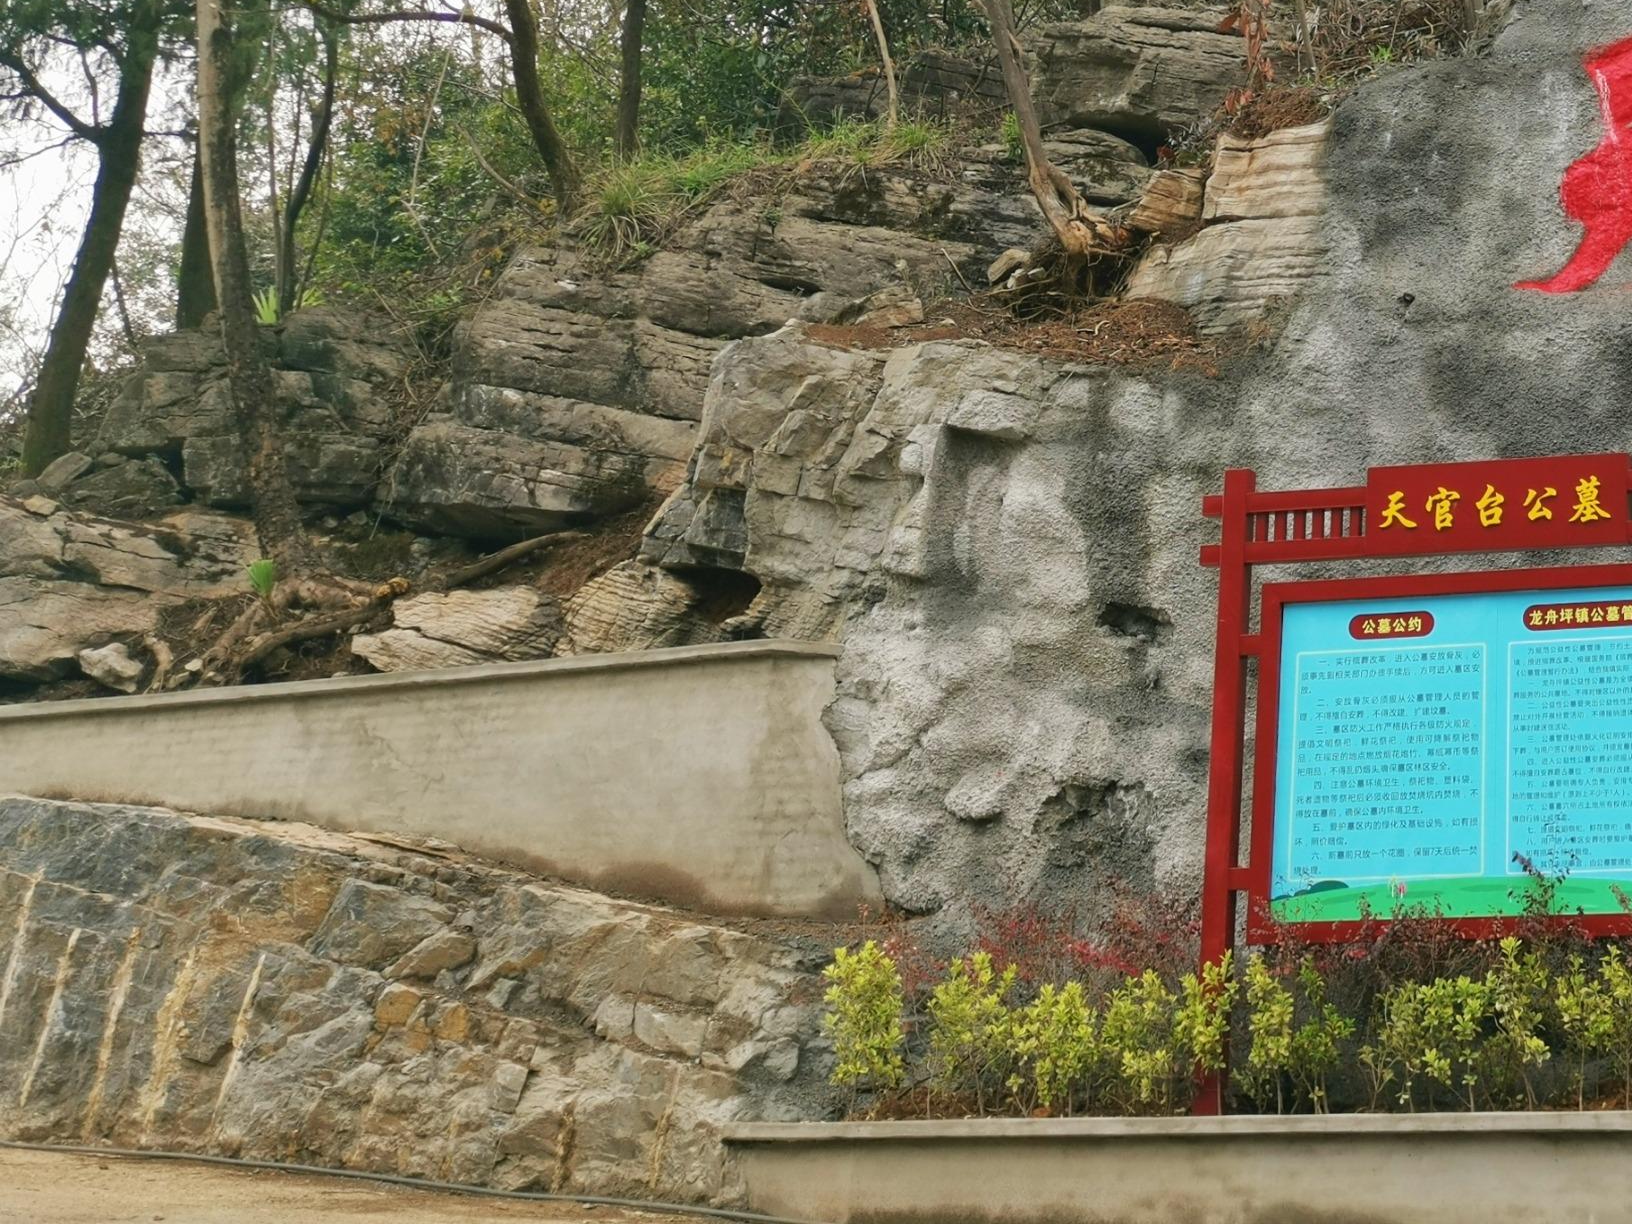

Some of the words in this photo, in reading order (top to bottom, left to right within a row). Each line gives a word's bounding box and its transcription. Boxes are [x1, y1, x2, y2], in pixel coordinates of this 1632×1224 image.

[1378, 477, 1612, 531] 天官台公墓
[1361, 613, 1423, 635] 公墓公约
